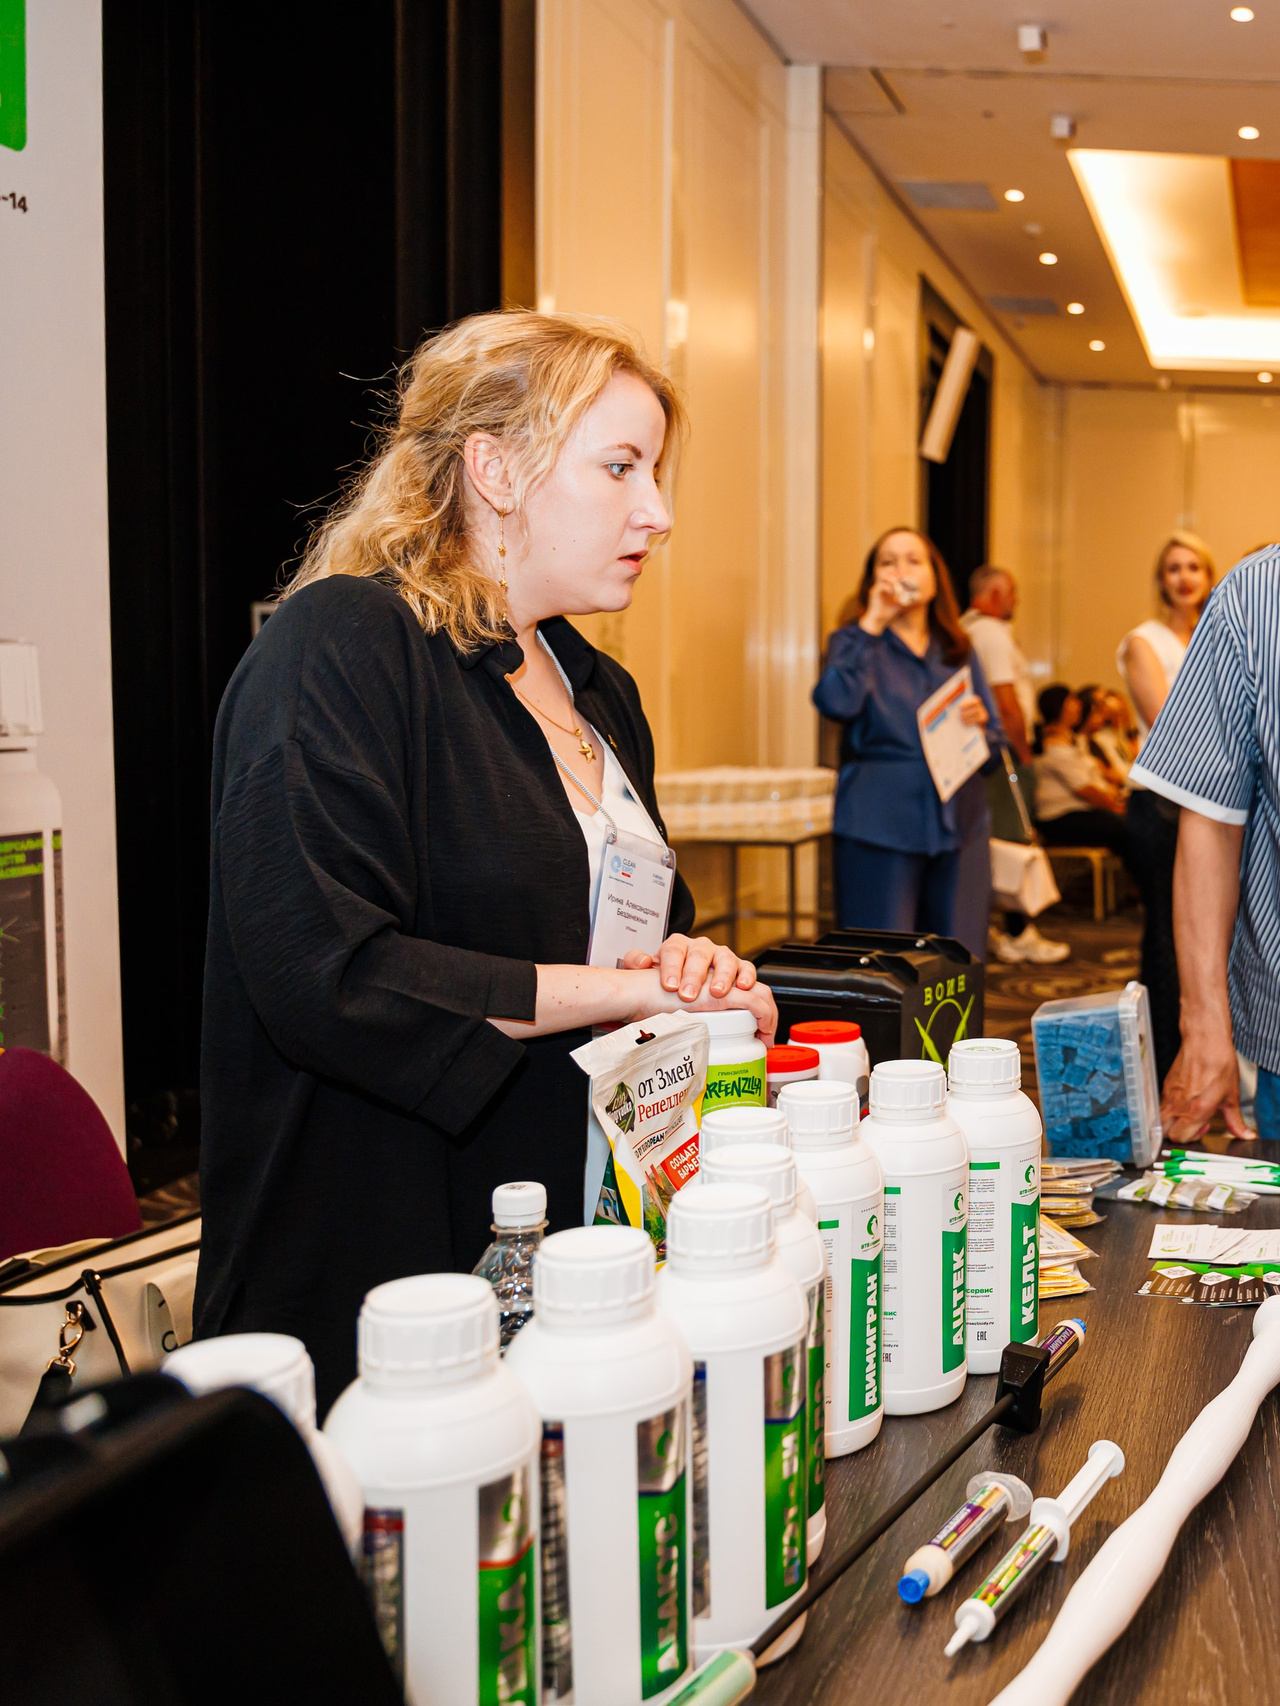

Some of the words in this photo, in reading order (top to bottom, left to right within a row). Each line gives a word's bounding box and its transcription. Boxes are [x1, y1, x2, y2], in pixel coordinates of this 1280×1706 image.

[0, 191, 28, 213] -14
[622, 858, 636, 869] CLEAN
[607, 893, 624, 905] Ирина
[923, 973, 966, 1006] ВОИН
[638, 1078, 655, 1099] от
[655, 1055, 695, 1090] Змей
[717, 1068, 749, 1077] ГРИНЗИЛЛА
[669, 1141, 699, 1171] СОЗДАЕТ
[1021, 1225, 1036, 1326] КЕЛЬТ
[952, 1247, 965, 1345] АЦТЕК
[864, 1273, 878, 1408] ДИМИГРАН
